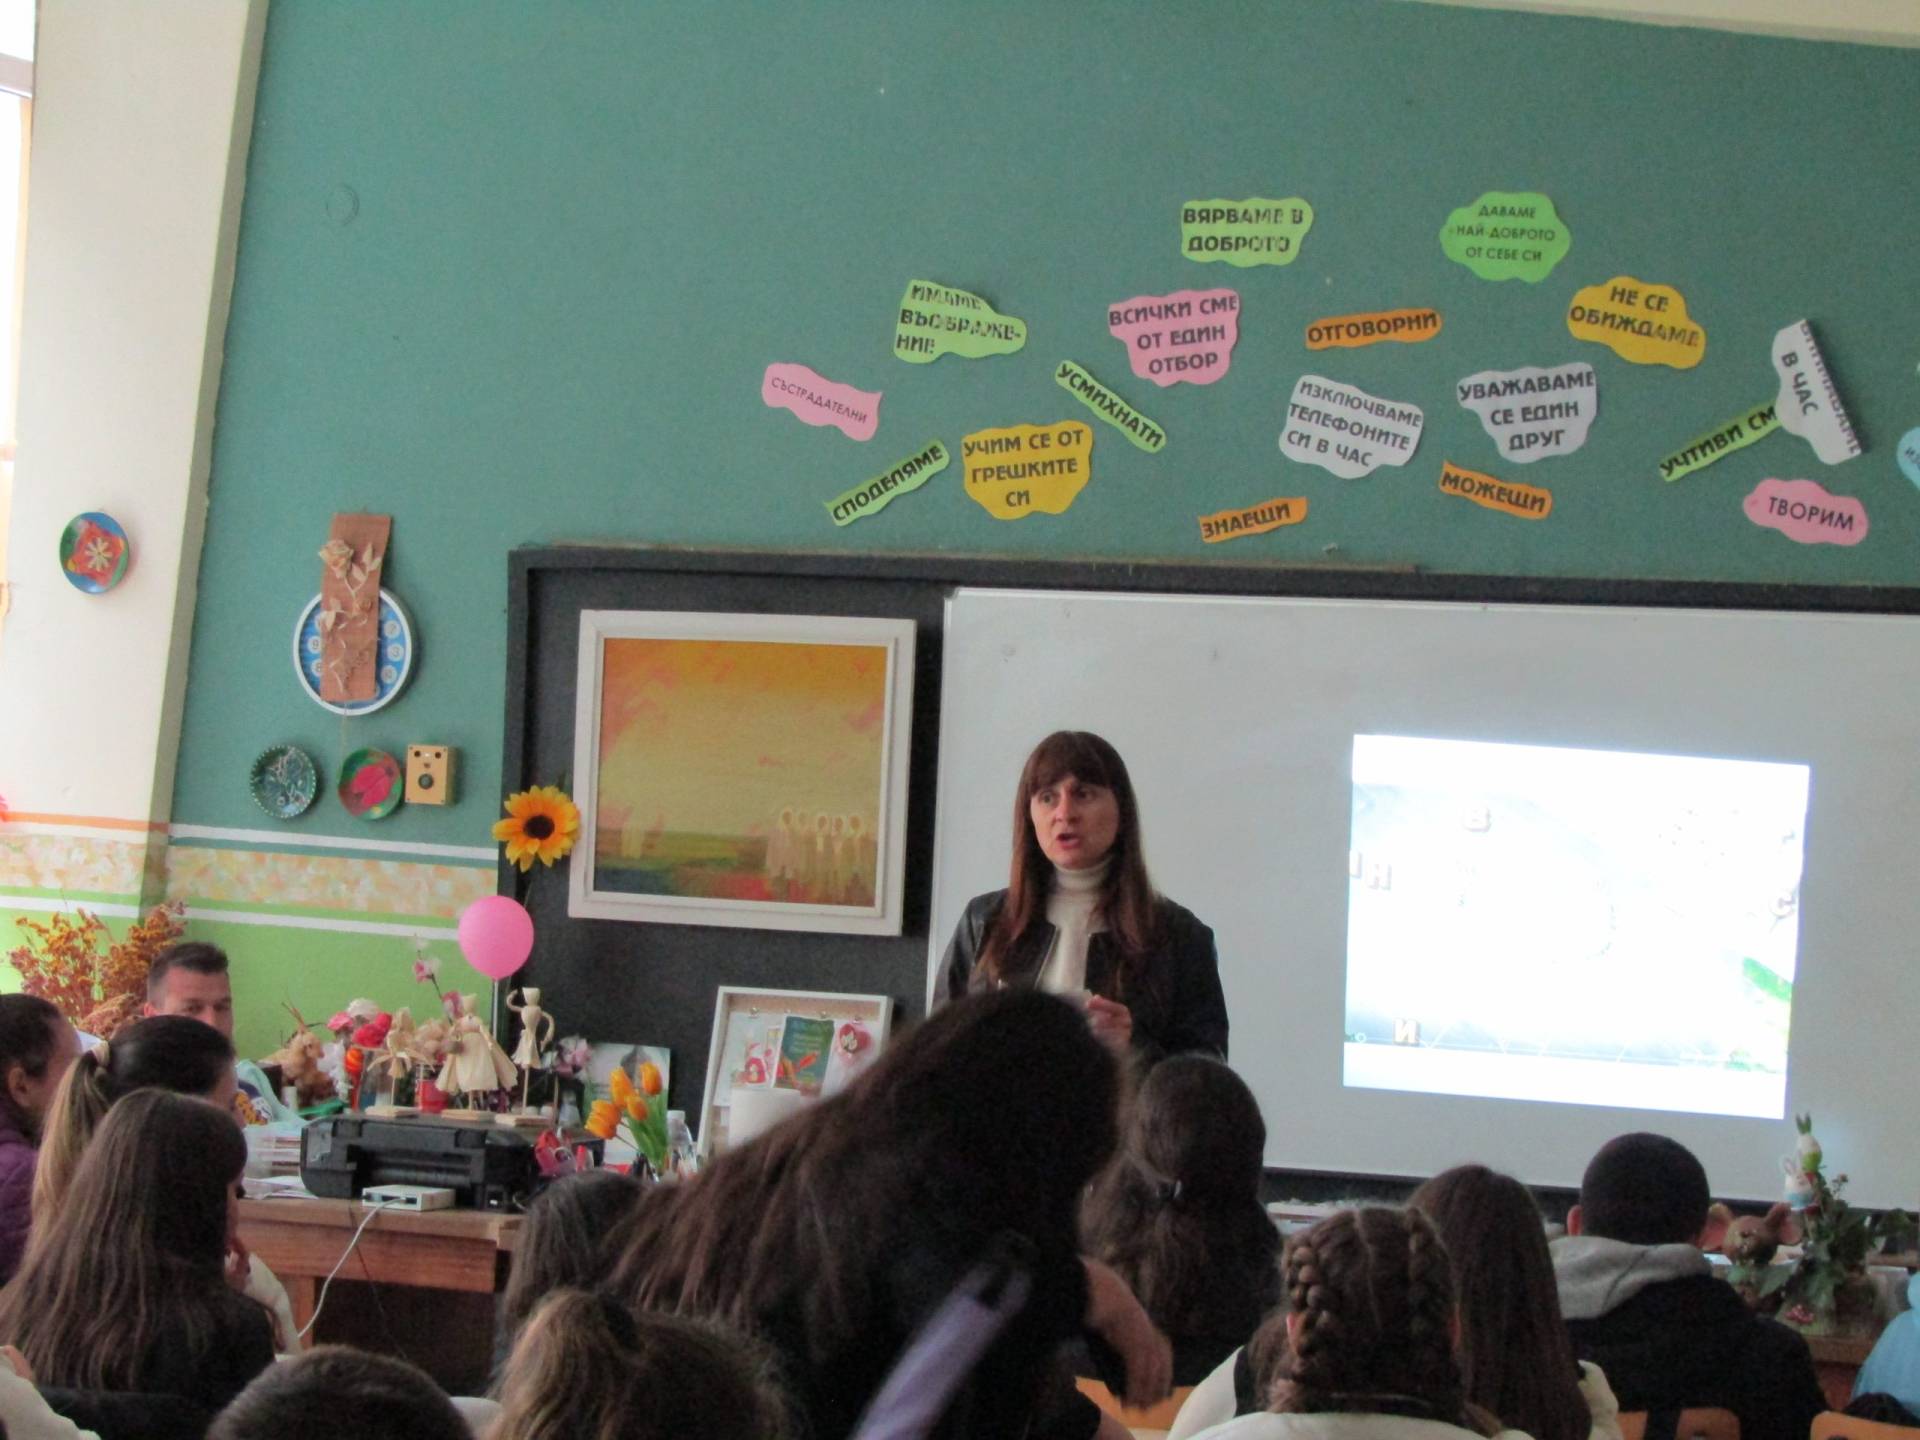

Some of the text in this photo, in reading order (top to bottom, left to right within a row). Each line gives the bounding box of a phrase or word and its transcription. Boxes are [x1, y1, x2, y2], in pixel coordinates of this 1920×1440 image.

[1183, 208, 1303, 224] ВЯРВАМЕ В
[1478, 205, 1536, 218] ДАВАМЕ
[1188, 236, 1290, 252] ДОБРОТО
[1466, 247, 1542, 262] ОТ СЕБЕ СИ
[1109, 295, 1237, 326] ВСИЧКИ СМЕ
[1610, 286, 1668, 313] НЕ СЕ
[1137, 325, 1225, 351] ОТ ЕДИН
[1308, 312, 1438, 344] ОТГОВОРНИ
[1570, 306, 1699, 348] ОБИЖДАМЕ
[896, 334, 935, 355] НИЕ
[1149, 352, 1219, 375] ОТБОР
[1458, 371, 1594, 401] УВАЖАВАМЕ
[1781, 352, 1818, 416] В ЧАС
[771, 377, 868, 424] СЪСТРАДАТЕЛНИ
[1057, 363, 1163, 448] УСМИХНАТИ
[1300, 381, 1422, 427] ИЗКЛЮЧВАМЕ
[1491, 401, 1579, 426] СЕ ЕДИН
[1290, 403, 1410, 451] ТЕЛЕФОНИТЕ
[1509, 429, 1565, 451] ДРУГ
[1660, 405, 1778, 476] УЧТИВИ СМ
[963, 429, 1084, 457] УЧИМ СЕ ОТ
[1287, 430, 1373, 467] СИ В ЧАС
[832, 445, 943, 522] СПОДЕЛЯМЕ
[971, 457, 1078, 483] ГРЕШКИТЕ
[1005, 490, 1030, 507] СИ
[1441, 471, 1546, 513] МОЖЕЩИ
[1202, 503, 1291, 539] ЗНАЕЩИ
[1769, 497, 1854, 531] ТВОРИМ
